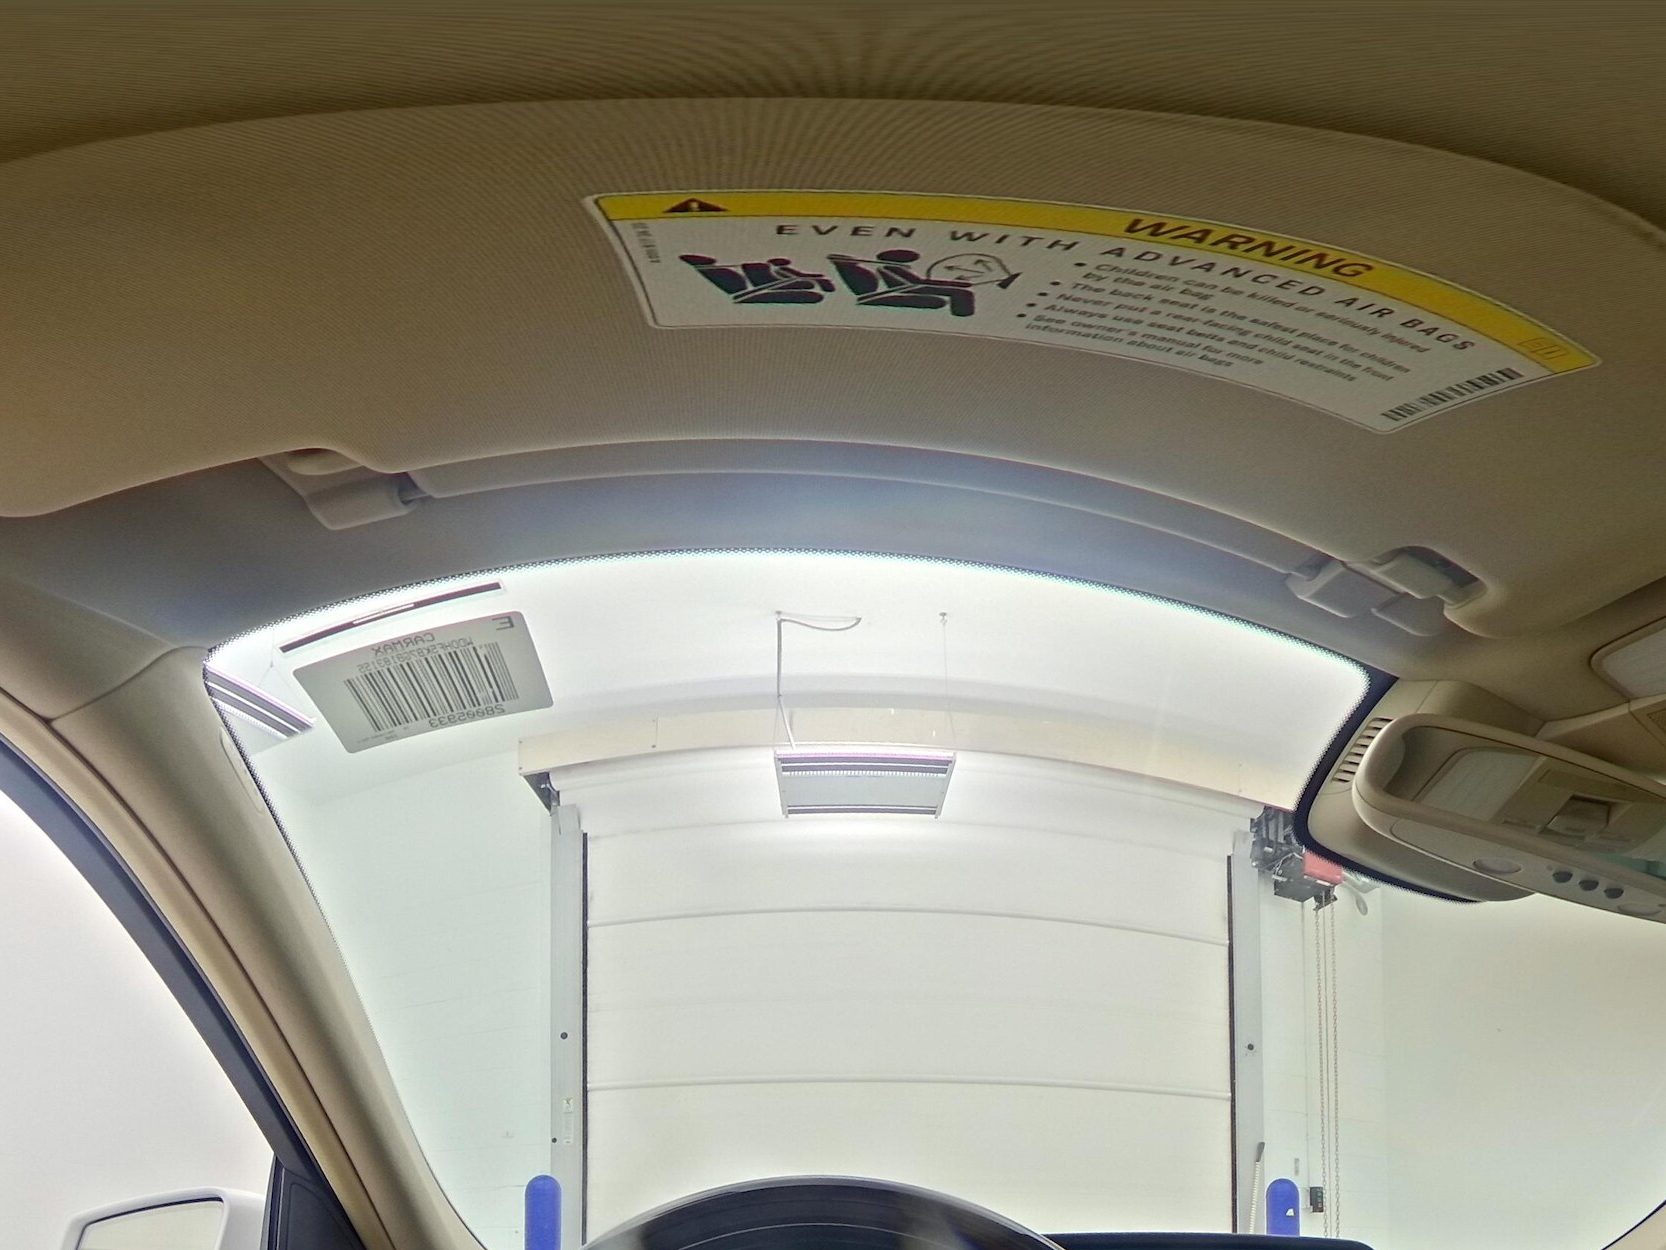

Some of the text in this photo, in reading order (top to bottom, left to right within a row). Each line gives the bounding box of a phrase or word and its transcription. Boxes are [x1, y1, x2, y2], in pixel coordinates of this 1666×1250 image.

[1083, 272, 1214, 301] by the air bag
[1124, 218, 1374, 278] WARNING
[775, 224, 1476, 350] EVEN WITH ADVANCED AIR BAGS
[1095, 264, 1181, 282] Children
[1183, 279, 1219, 290] can
[1220, 286, 1244, 296] be
[1247, 292, 1296, 308] killed
[1315, 311, 1381, 335] seriously
[1381, 332, 1431, 353] injured
[1025, 322, 1233, 367] information about air bags
[1033, 314, 1264, 365] See owner's manual for more
[1044, 304, 1357, 381] Always use seat belts and child restraints
[1055, 293, 1111, 306] Never
[1114, 303, 1148, 313] put
[1165, 312, 1253, 337] rear-facing
[1253, 331, 1293, 346] child
[1292, 342, 1324, 355] seat
[1339, 357, 1362, 368] the
[1362, 365, 1395, 381] front
[1071, 282, 1411, 373] The back seat is the safest place for children
